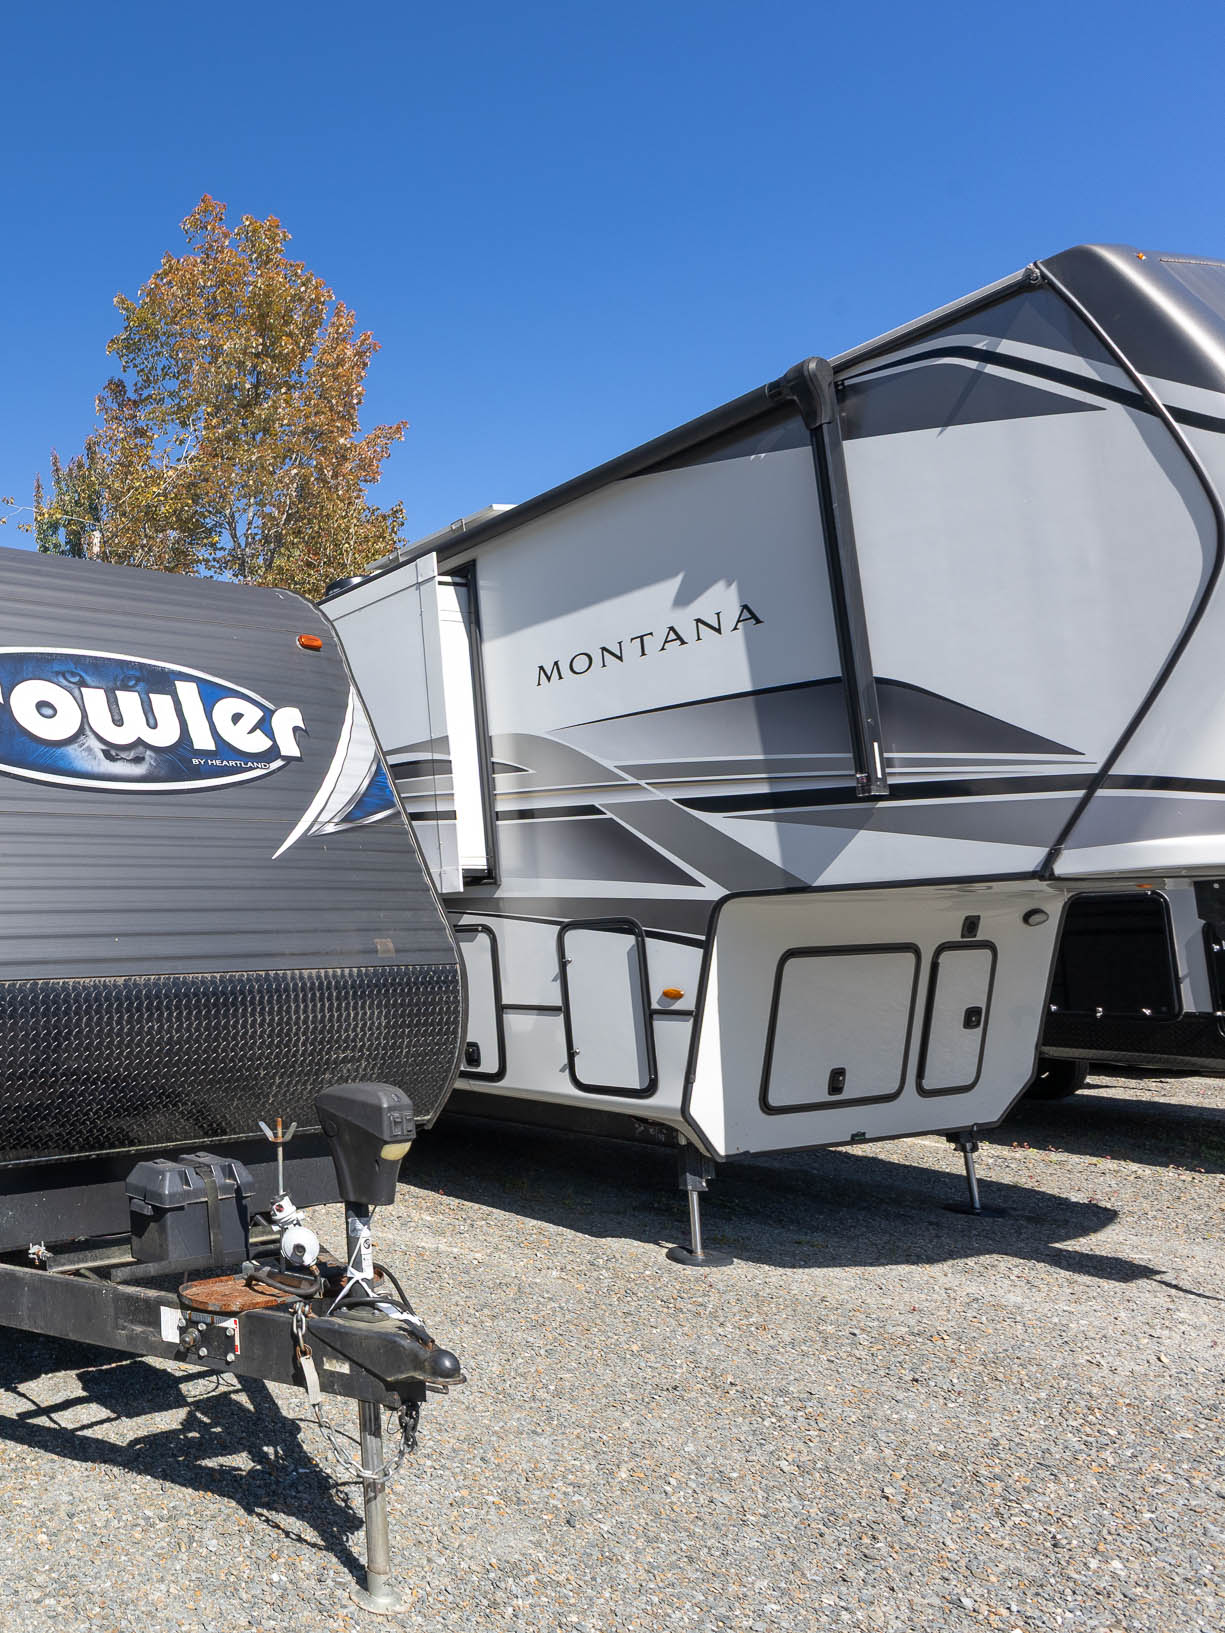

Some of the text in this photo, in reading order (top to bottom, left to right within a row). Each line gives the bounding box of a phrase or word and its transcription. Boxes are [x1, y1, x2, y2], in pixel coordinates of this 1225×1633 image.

[536, 603, 764, 687] MONTANA
[191, 758, 269, 769] BY HEARTLAND
